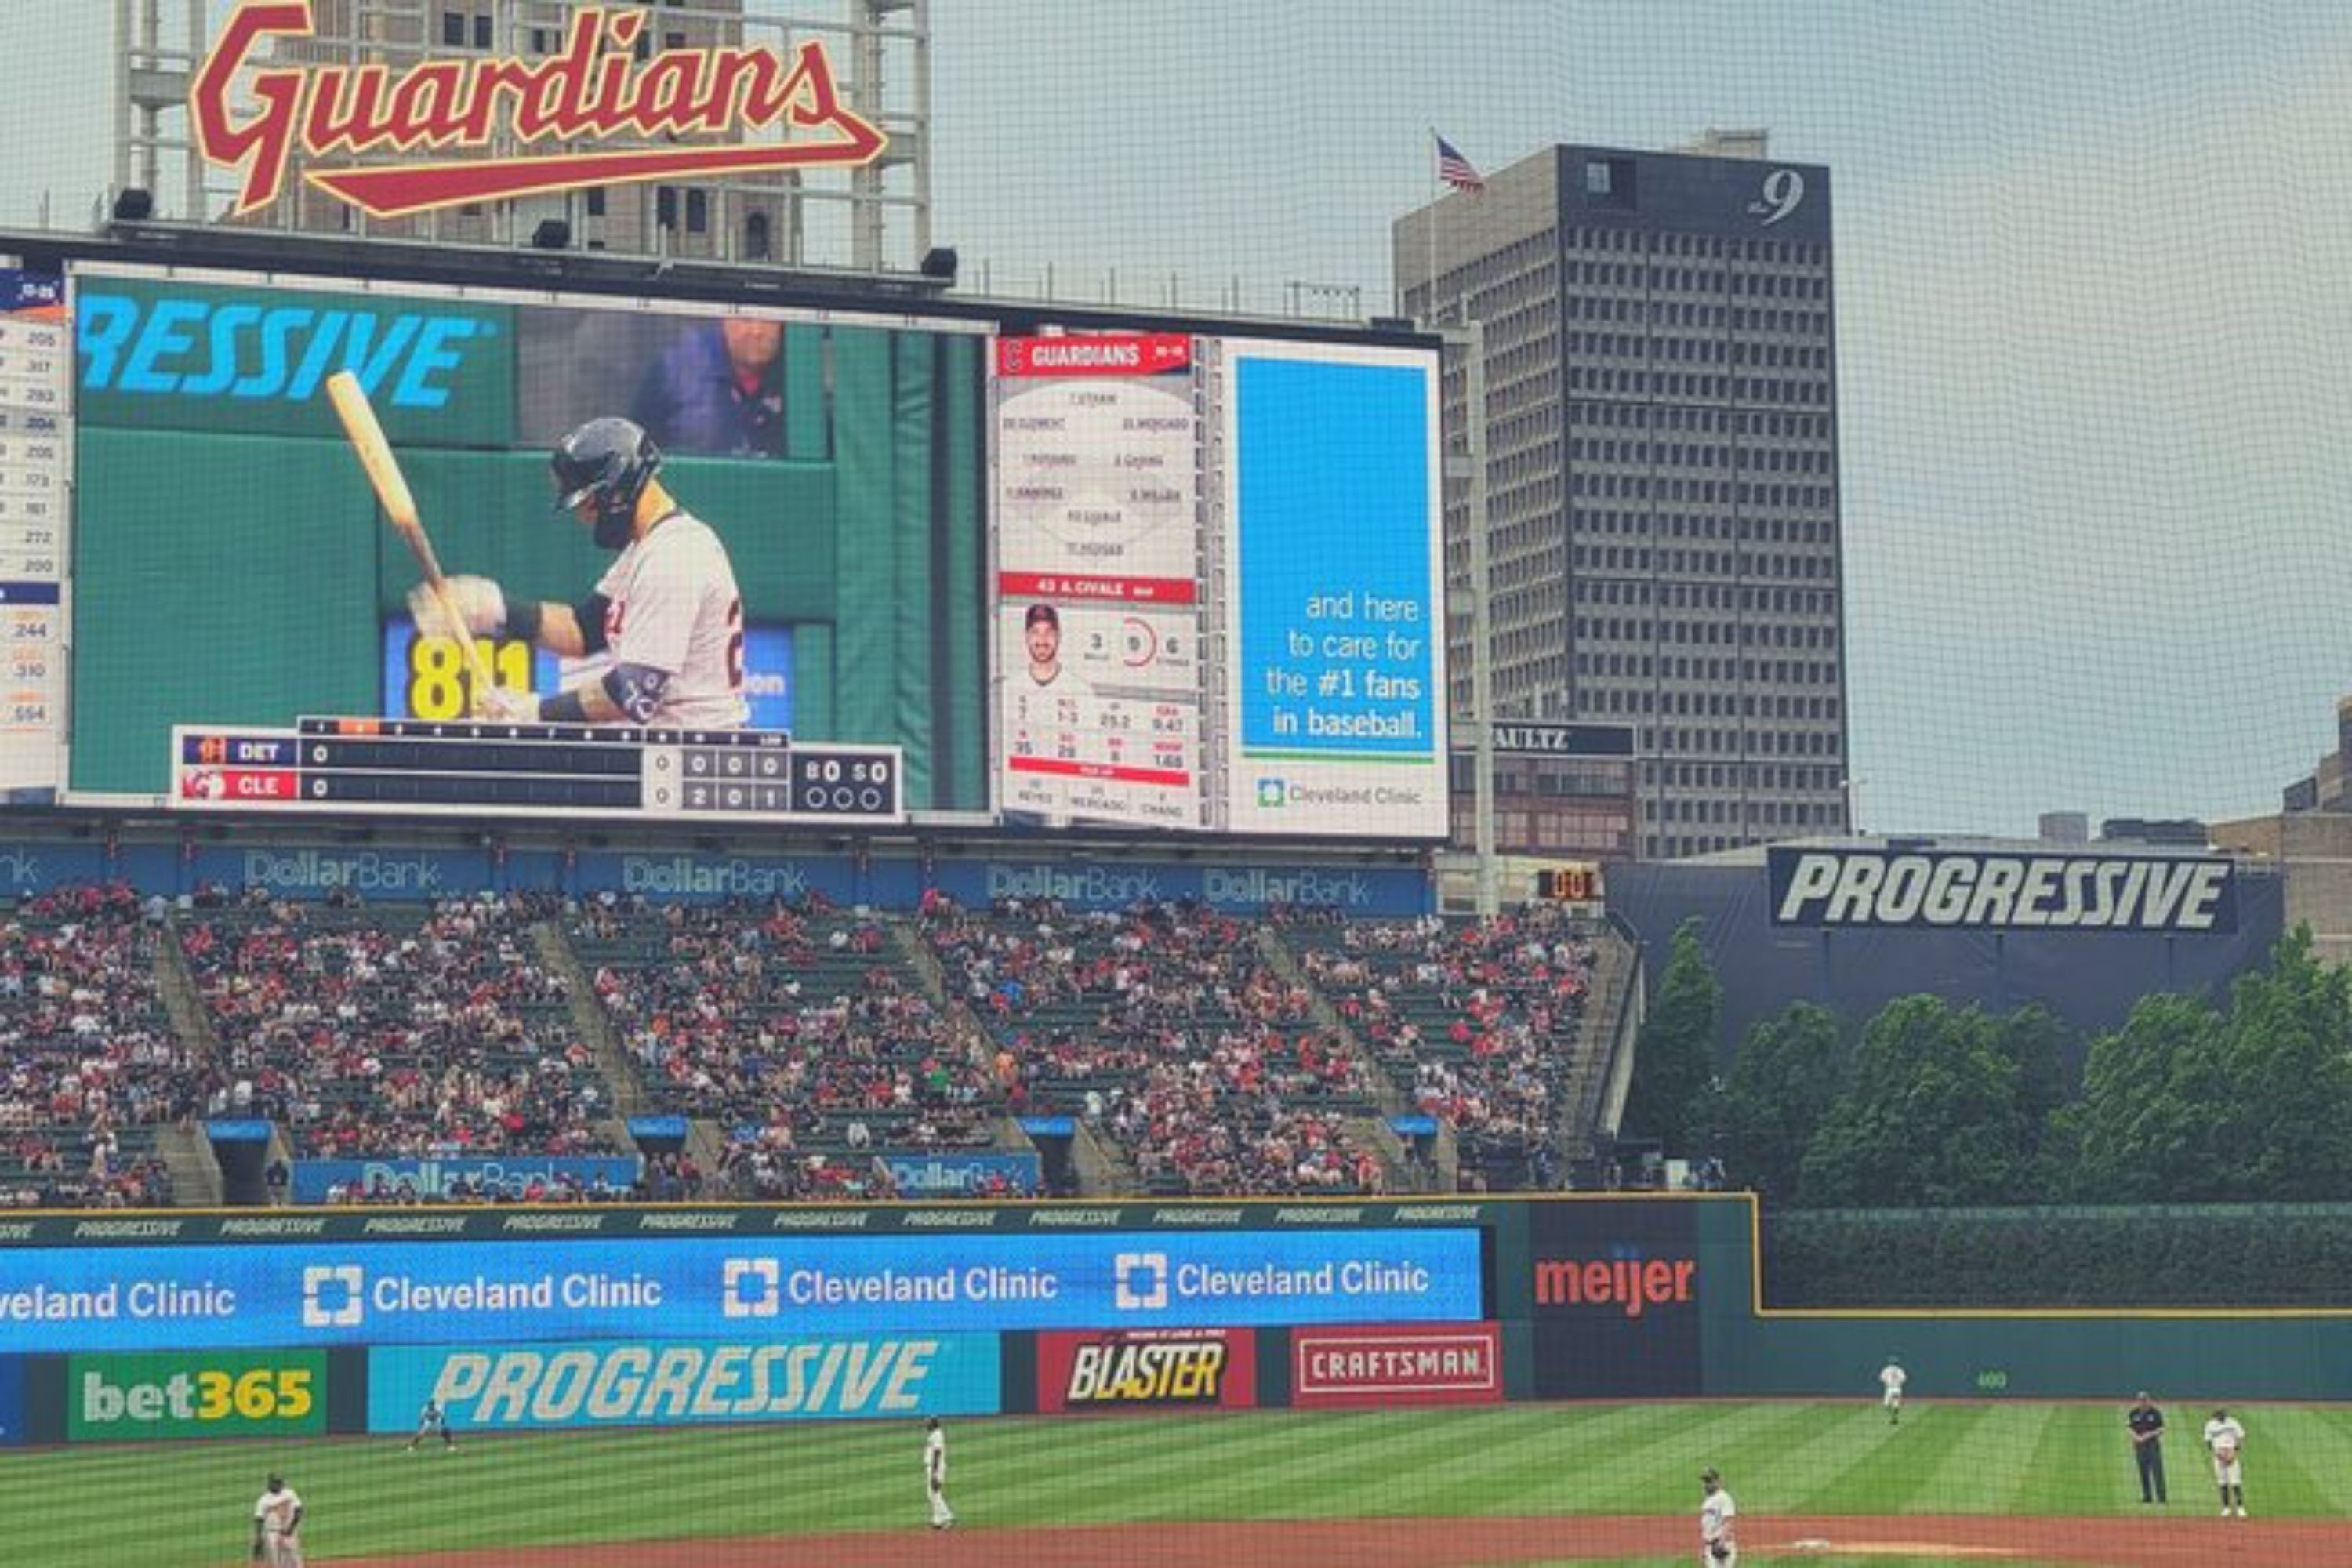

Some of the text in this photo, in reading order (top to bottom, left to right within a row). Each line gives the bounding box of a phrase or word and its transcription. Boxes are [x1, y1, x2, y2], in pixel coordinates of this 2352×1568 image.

[188, 0, 862, 216] Guardians
[1761, 170, 1804, 226] 9
[78, 292, 474, 408] RESSIVE
[1031, 345, 1140, 366] GUARDIANS
[1306, 592, 1418, 621] and here
[1091, 633, 1102, 650] 3
[1289, 630, 1420, 660] to care for
[1266, 667, 1421, 699] the #1 fans
[1273, 706, 1421, 738] in baseball.
[239, 745, 777, 774] DET 0 0 0 0 0
[238, 778, 775, 806] CLE 0 0 2 0 1
[1290, 786, 1421, 804] Cleveland Clinic
[245, 848, 438, 887] DollarBank
[626, 856, 806, 894] DollarBank
[989, 864, 1160, 901] DollarBank
[1204, 868, 1370, 906] DollarBank
[1778, 855, 2228, 928] PROGRESSIVE
[375, 1274, 662, 1312] Cleveland Clinic
[789, 1266, 1057, 1304] Cleveland Clinic
[1177, 1261, 1428, 1297] Cleveland Clinic
[1534, 1250, 1695, 1318] meijer
[129, 1281, 235, 1318] Clinic
[433, 1341, 938, 1422] PROGRESSIVE
[1068, 1341, 1224, 1402] BLASTER
[1312, 1349, 1480, 1380] CRAFTSMAN
[85, 1369, 311, 1421] bet365
